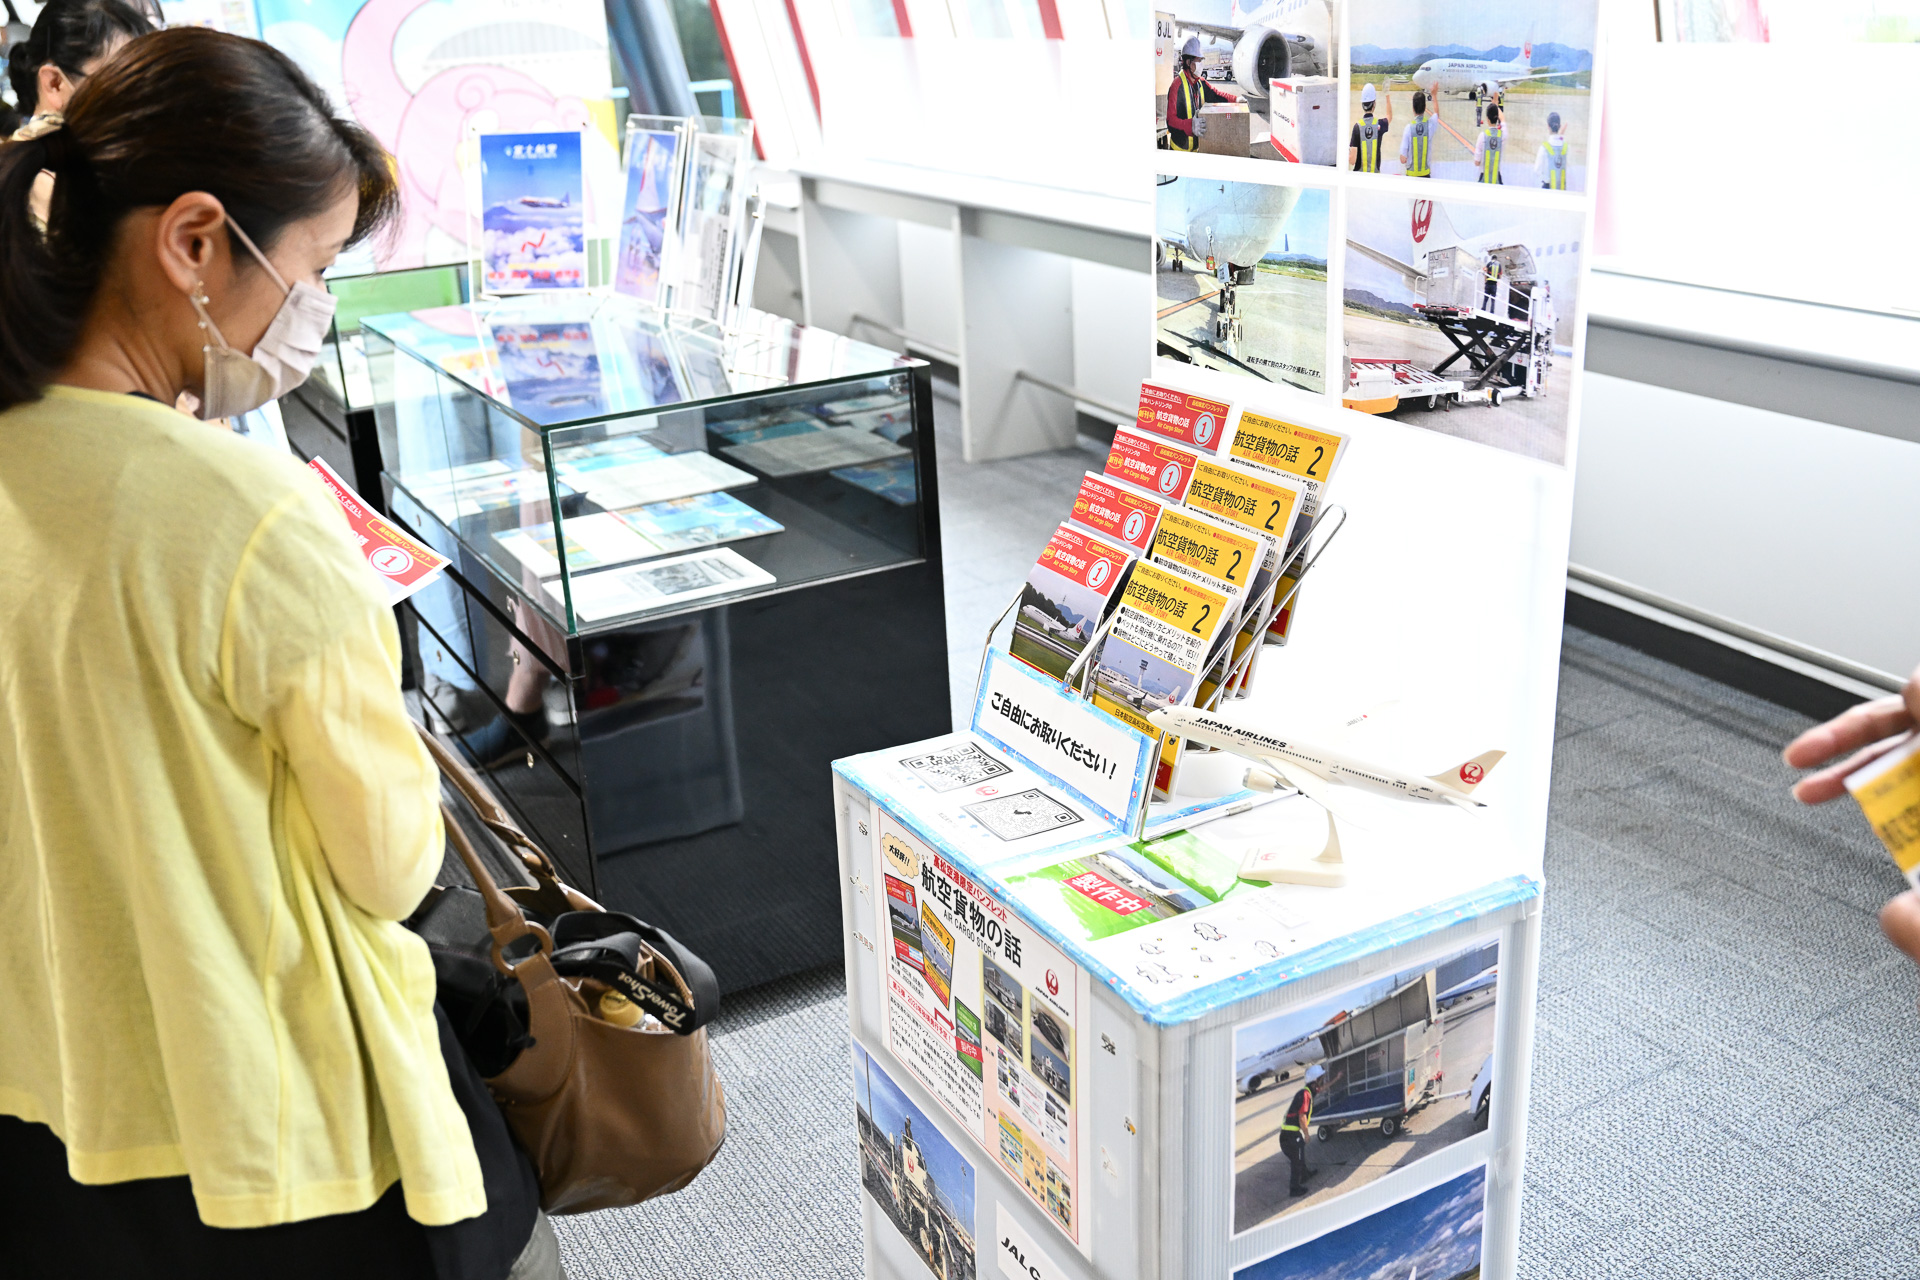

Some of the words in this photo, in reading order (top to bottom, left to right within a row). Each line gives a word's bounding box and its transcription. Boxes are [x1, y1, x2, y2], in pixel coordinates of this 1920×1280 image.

[1157, 21, 1162, 37] 8
[1163, 22, 1171, 38] JL
[1415, 226, 1427, 238] JAL
[1156, 410, 1190, 428] 航空貨物の話
[1163, 423, 1173, 432] Cargo
[1173, 426, 1184, 435] Story
[1199, 422, 1207, 438] 1
[1232, 429, 1301, 463] 航空貨物の話
[1123, 457, 1157, 476] 航空貨物の話
[1242, 449, 1252, 457] AIR
[1252, 452, 1266, 462] CARGO
[1266, 456, 1281, 466] STORY
[1306, 445, 1324, 476] 2
[1129, 470, 1140, 479] Cargo
[1140, 474, 1150, 483] Story
[1164, 471, 1174, 487] 1
[1189, 478, 1258, 517] 航空貨物の話
[1088, 503, 1121, 523] 航空貨物の話
[1209, 502, 1224, 512] CARGO
[1225, 507, 1239, 518] STORY
[1265, 500, 1280, 531] 2
[1093, 516, 1104, 526] Cargo
[1104, 520, 1114, 530] Story
[1128, 519, 1138, 535] 1
[1156, 527, 1219, 566] 航空貨物の話
[381, 555, 398, 568] 1
[1054, 549, 1087, 570] 航空貨物の話
[1059, 562, 1069, 571] Cargo
[1068, 566, 1078, 576] Story
[1175, 552, 1187, 562] CARGO
[1188, 556, 1201, 567] STORY
[1226, 549, 1242, 580] 2
[1092, 566, 1103, 582] 1
[1125, 579, 1188, 618] 航空貨物の話
[1133, 599, 1141, 607] AIR
[1142, 603, 1154, 614] CARGO
[1155, 608, 1168, 620] STORY
[1192, 604, 1210, 634] 2
[1124, 608, 1202, 650] 航空貨物の送り方とメリットを紹介
[1186, 649, 1200, 661] YES!!
[991, 691, 1117, 780] ご自由にお取りください！
[1195, 717, 1232, 731] JAPAN
[1233, 728, 1288, 748] AIRLINES
[933, 854, 1008, 922] 高松空港限定パンフレット
[1071, 873, 1143, 912] 製作中
[921, 861, 1022, 969] 航空貨物の話
[944, 909, 953, 924] AIR
[954, 918, 975, 943] CARGO
[976, 936, 997, 960] STORY
[946, 937, 951, 950] 2
[618, 971, 687, 1028] PowerShot
[1035, 986, 1049, 999] JAPAN
[1049, 998, 1069, 1016] AIRLINES
[1001, 1237, 1041, 1280] JALC
